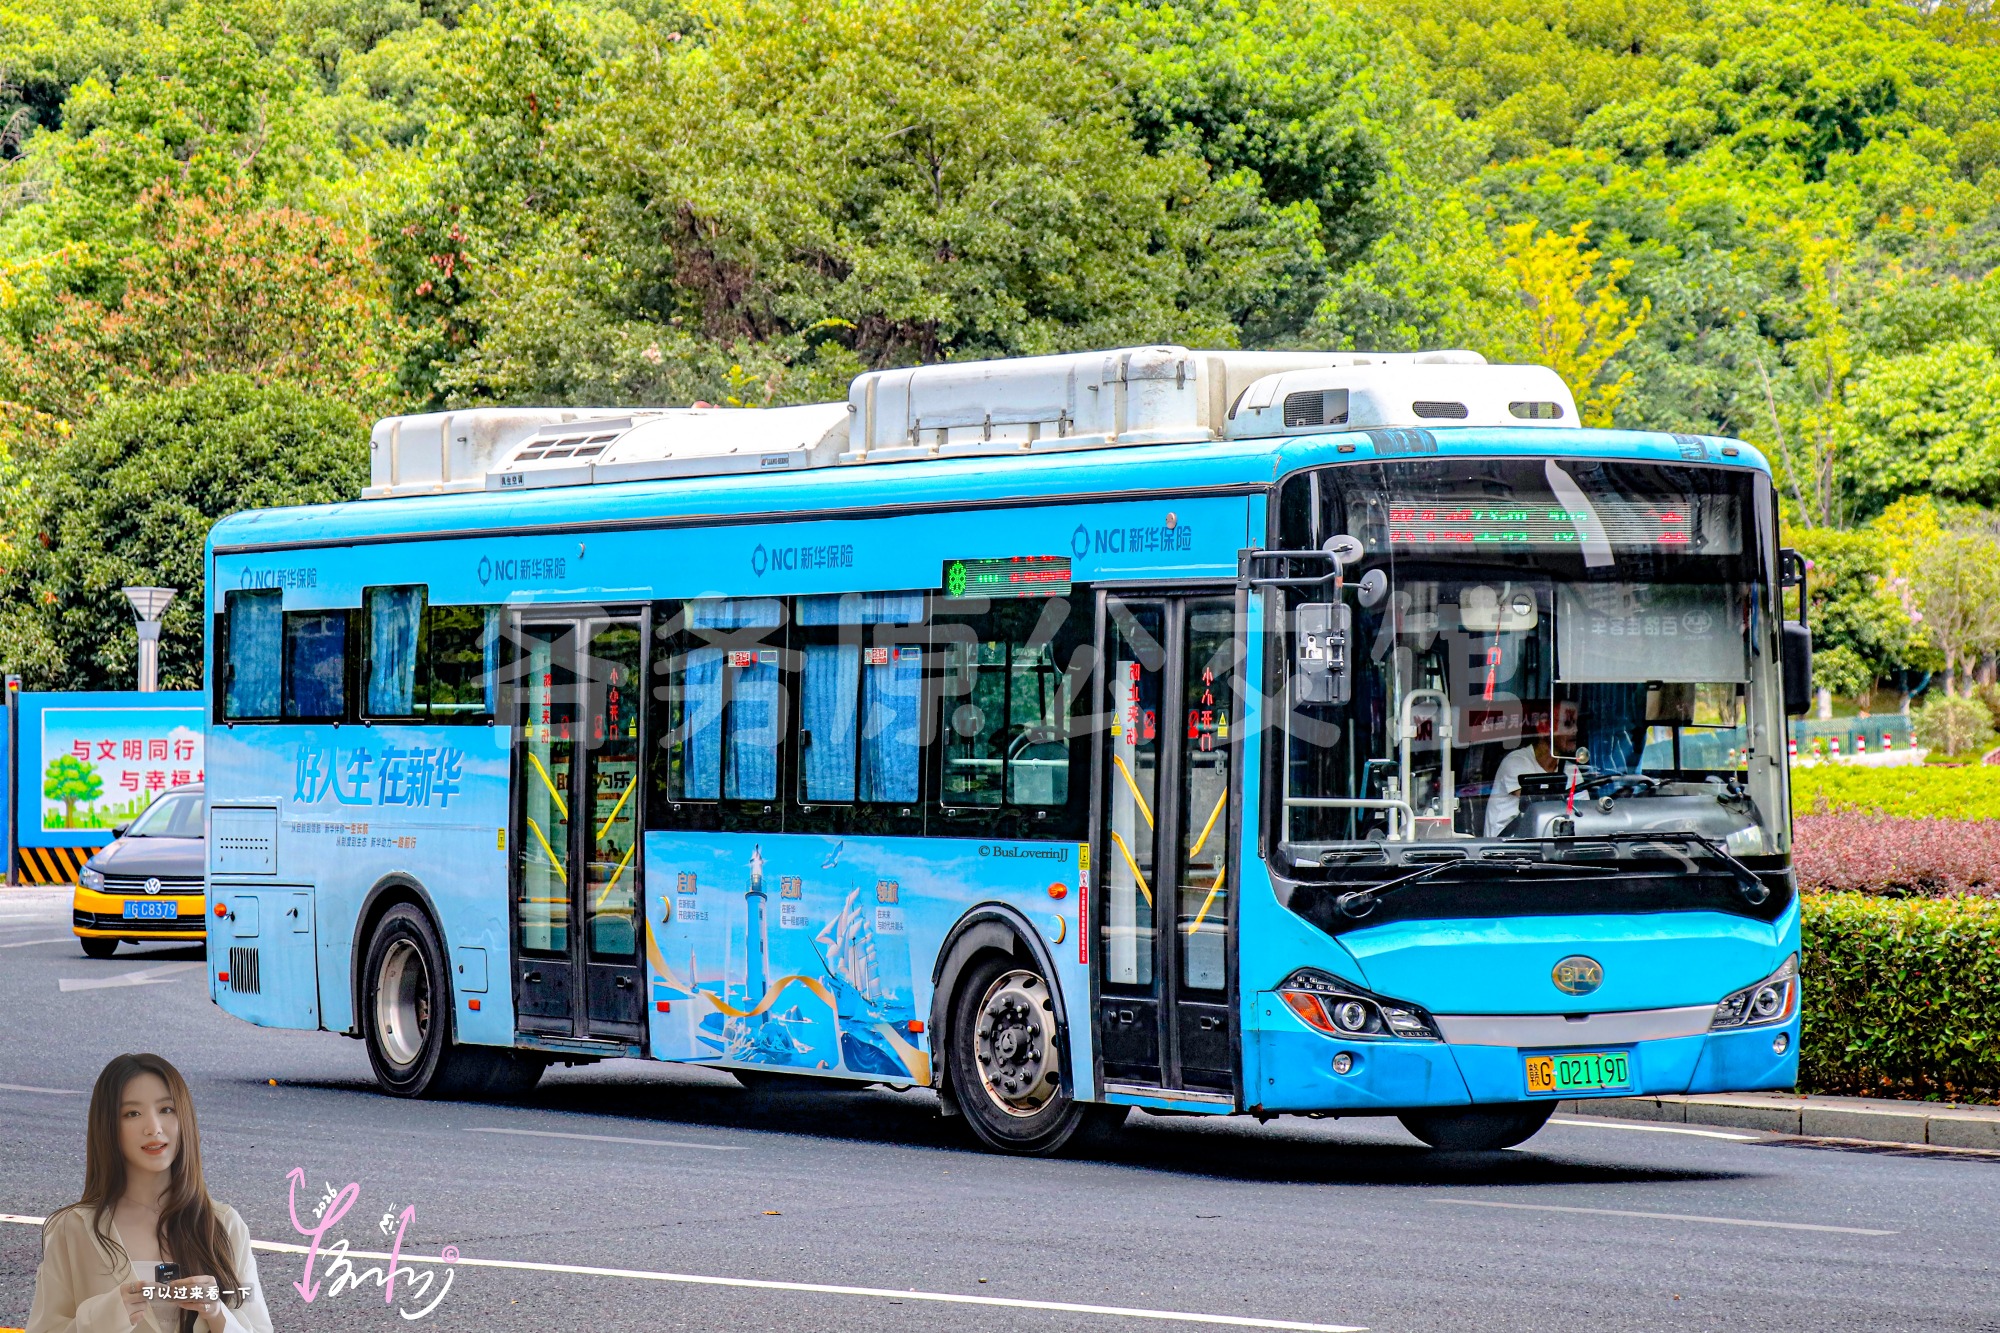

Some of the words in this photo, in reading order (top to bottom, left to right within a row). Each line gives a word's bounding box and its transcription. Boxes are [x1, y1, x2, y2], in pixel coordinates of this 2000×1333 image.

[1095, 529, 1125, 554] NCI
[1129, 525, 1192, 553] 新华保险
[495, 560, 517, 581] NCI
[520, 557, 565, 580] 新华保险
[772, 548, 797, 570] NCI
[801, 544, 853, 569] 新华保险
[255, 570, 275, 588] NCI
[278, 567, 316, 589] 新华保险
[71, 738, 195, 761] 与文明同行
[119, 769, 205, 791] 与幸福
[293, 745, 373, 807] 好人生
[378, 744, 466, 809] 在新华
[677, 871, 697, 895] 启航
[781, 875, 802, 900] 远航
[1560, 966, 1600, 983] BLK
